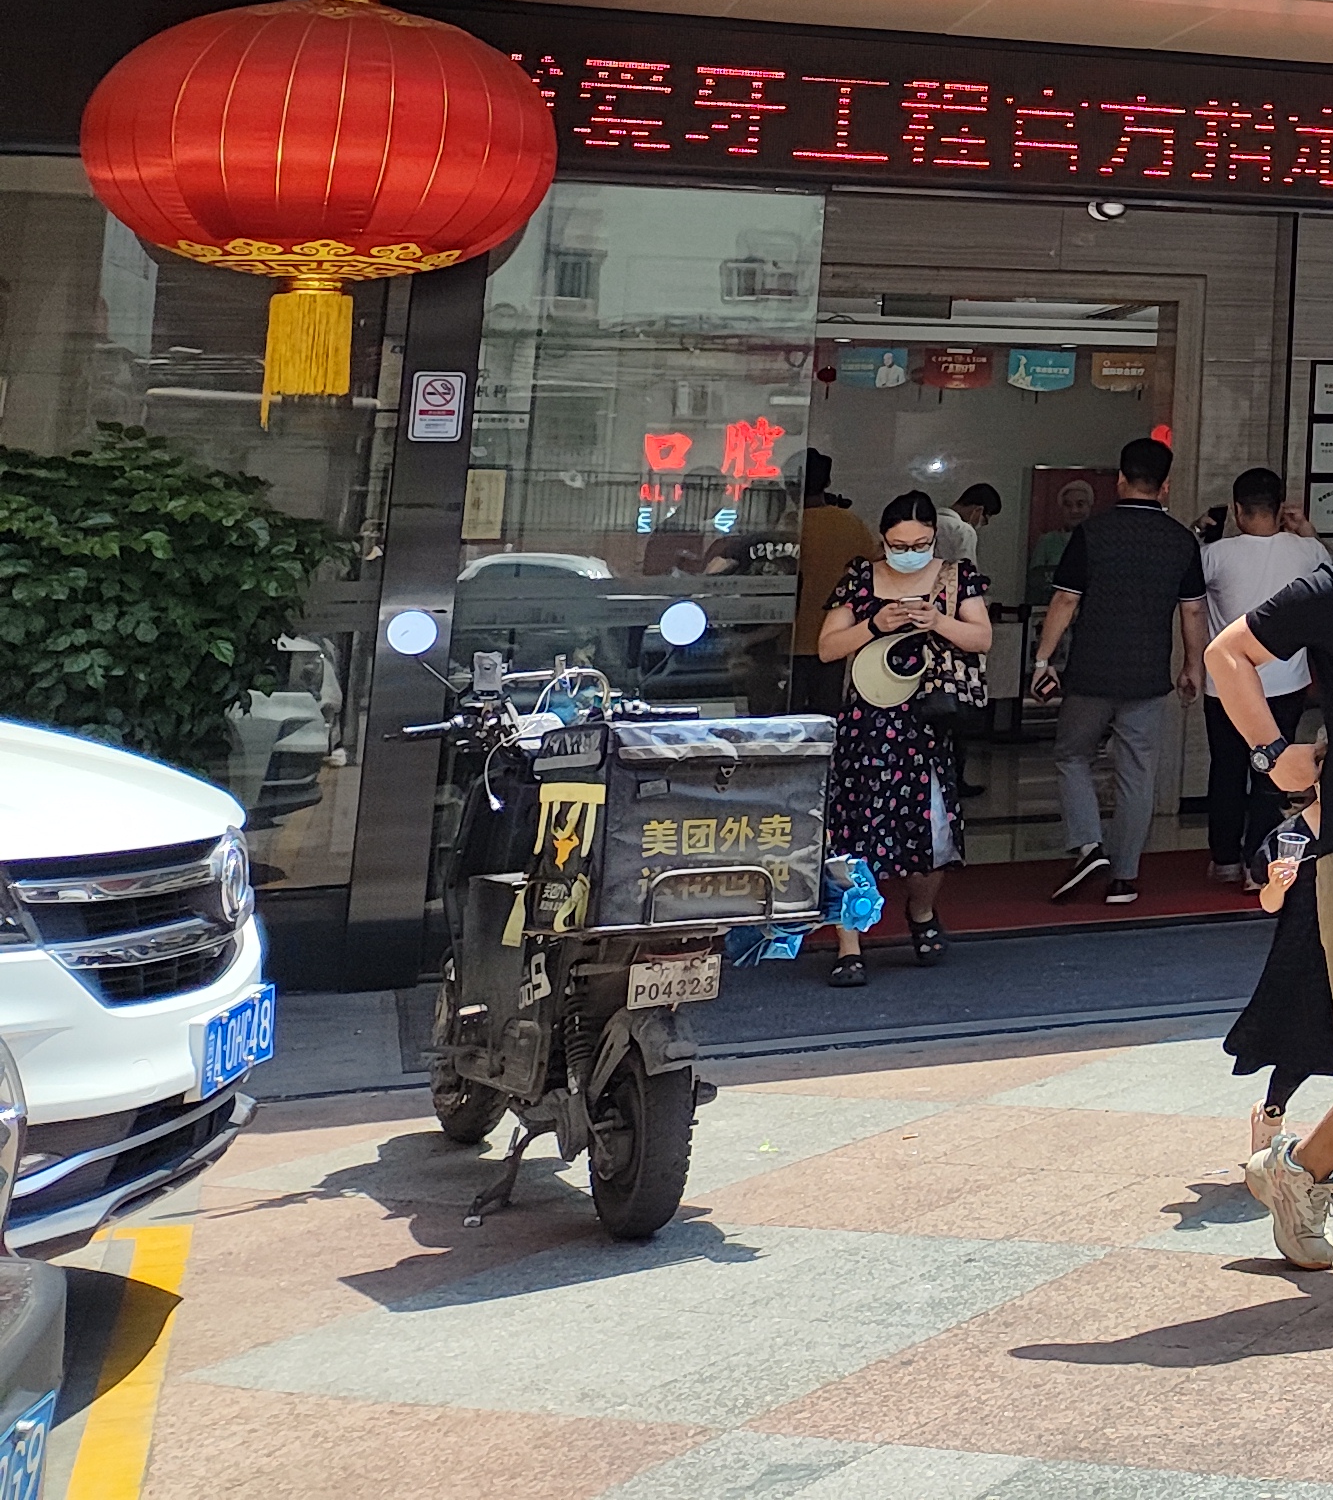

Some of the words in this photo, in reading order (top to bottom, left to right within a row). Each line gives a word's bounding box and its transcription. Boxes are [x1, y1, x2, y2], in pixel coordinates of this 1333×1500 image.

[644, 416, 787, 478] 口腔
[641, 813, 793, 859] 美团外卖
[633, 975, 715, 1003] P04323
